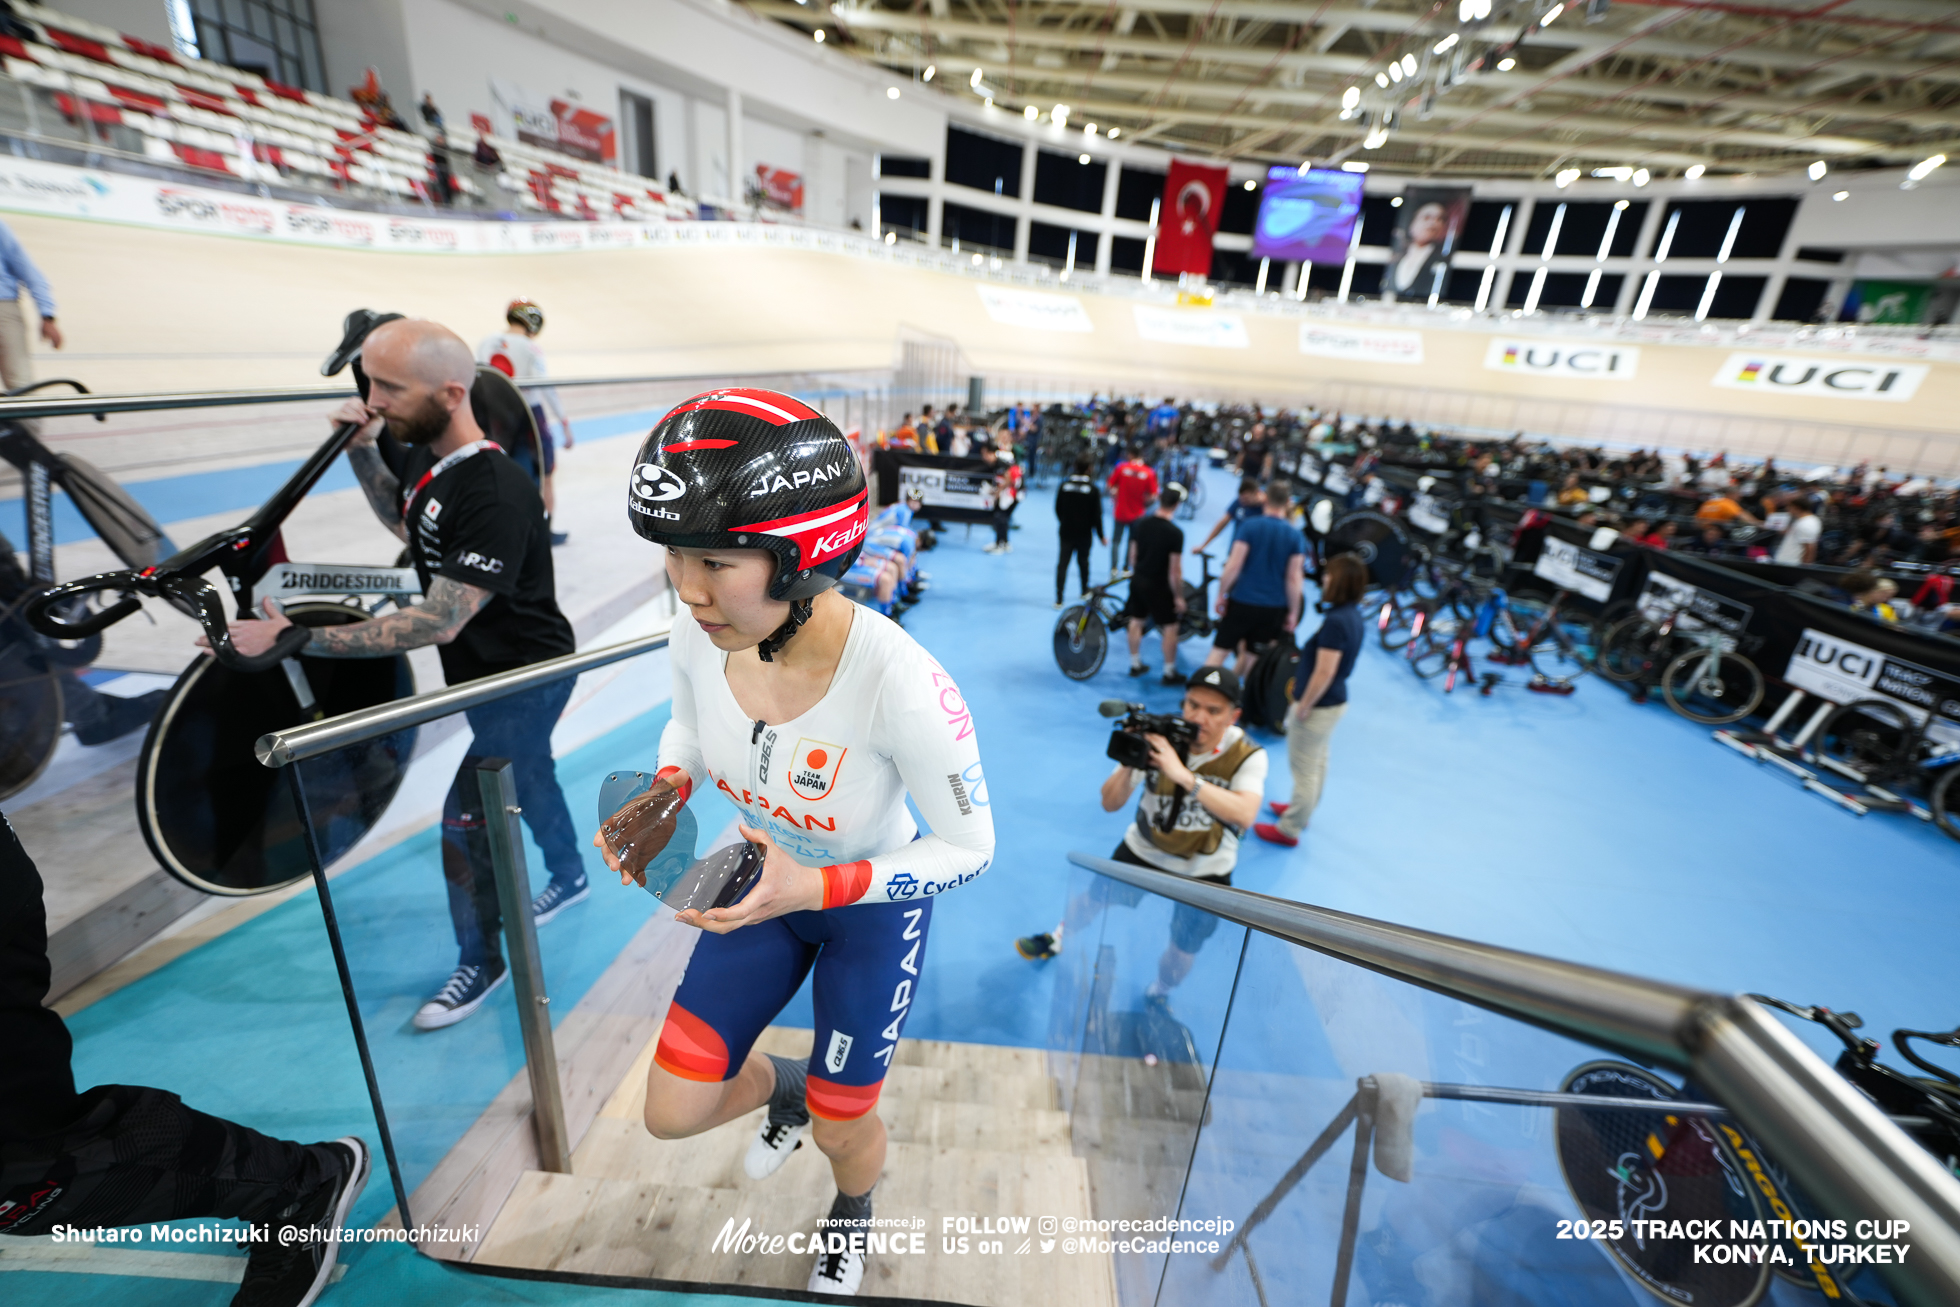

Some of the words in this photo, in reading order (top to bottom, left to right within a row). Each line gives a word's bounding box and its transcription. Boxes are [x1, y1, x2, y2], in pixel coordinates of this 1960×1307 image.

[1525, 348, 1620, 373] UCI
[1768, 363, 1901, 392] UCI
[750, 461, 842, 497] JAPAN
[629, 497, 680, 521] Kabuto
[281, 571, 405, 589] BRIDGESTONE
[1813, 642, 1873, 680] UCI
[759, 730, 778, 785] Q36.5
[794, 775, 827, 791] JAPAN
[803, 770, 821, 780] TEAM
[947, 773, 973, 816] KEIRIN
[923, 859, 989, 896] Cyclers
[873, 907, 923, 1067] JAPAN
[833, 1036, 849, 1068] Q36.5
